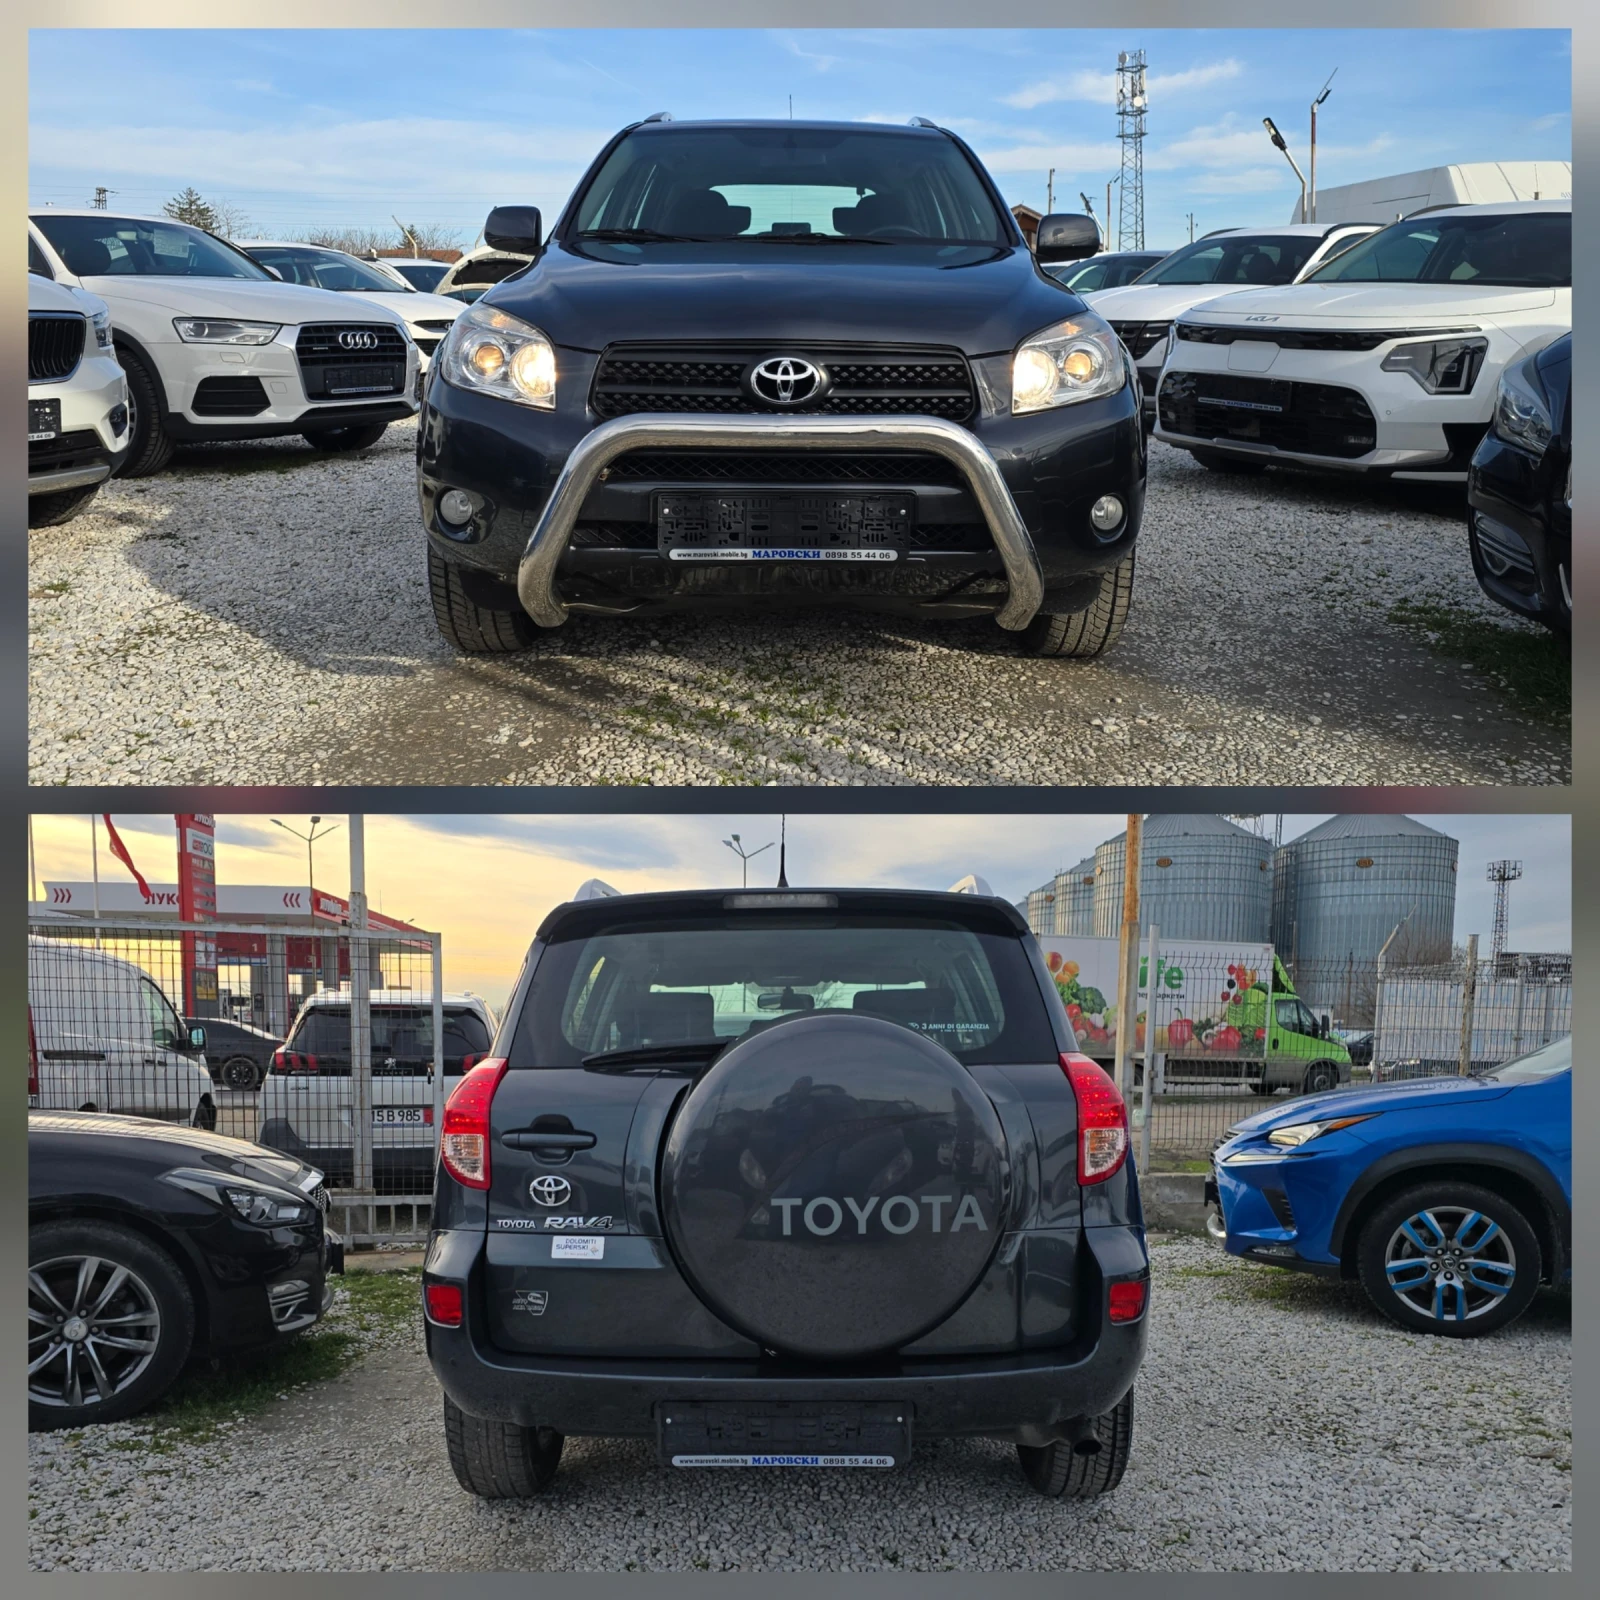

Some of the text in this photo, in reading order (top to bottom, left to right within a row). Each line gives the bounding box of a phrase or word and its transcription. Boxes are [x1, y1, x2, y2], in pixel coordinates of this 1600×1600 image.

[752, 550, 820, 558] МАРОВСКИ
[825, 551, 848, 559] 0898
[1138, 956, 1184, 990] ife
[921, 1022, 927, 1030] 3
[371, 1110, 421, 1122] 15 B 985
[771, 1195, 988, 1236] TOYOTA
[497, 1216, 613, 1230] TOYOTA RAV4
[752, 1456, 819, 1465] МАРОВСКИ
[823, 1457, 846, 1465] 0898
[876, 1458, 888, 1466] 06
